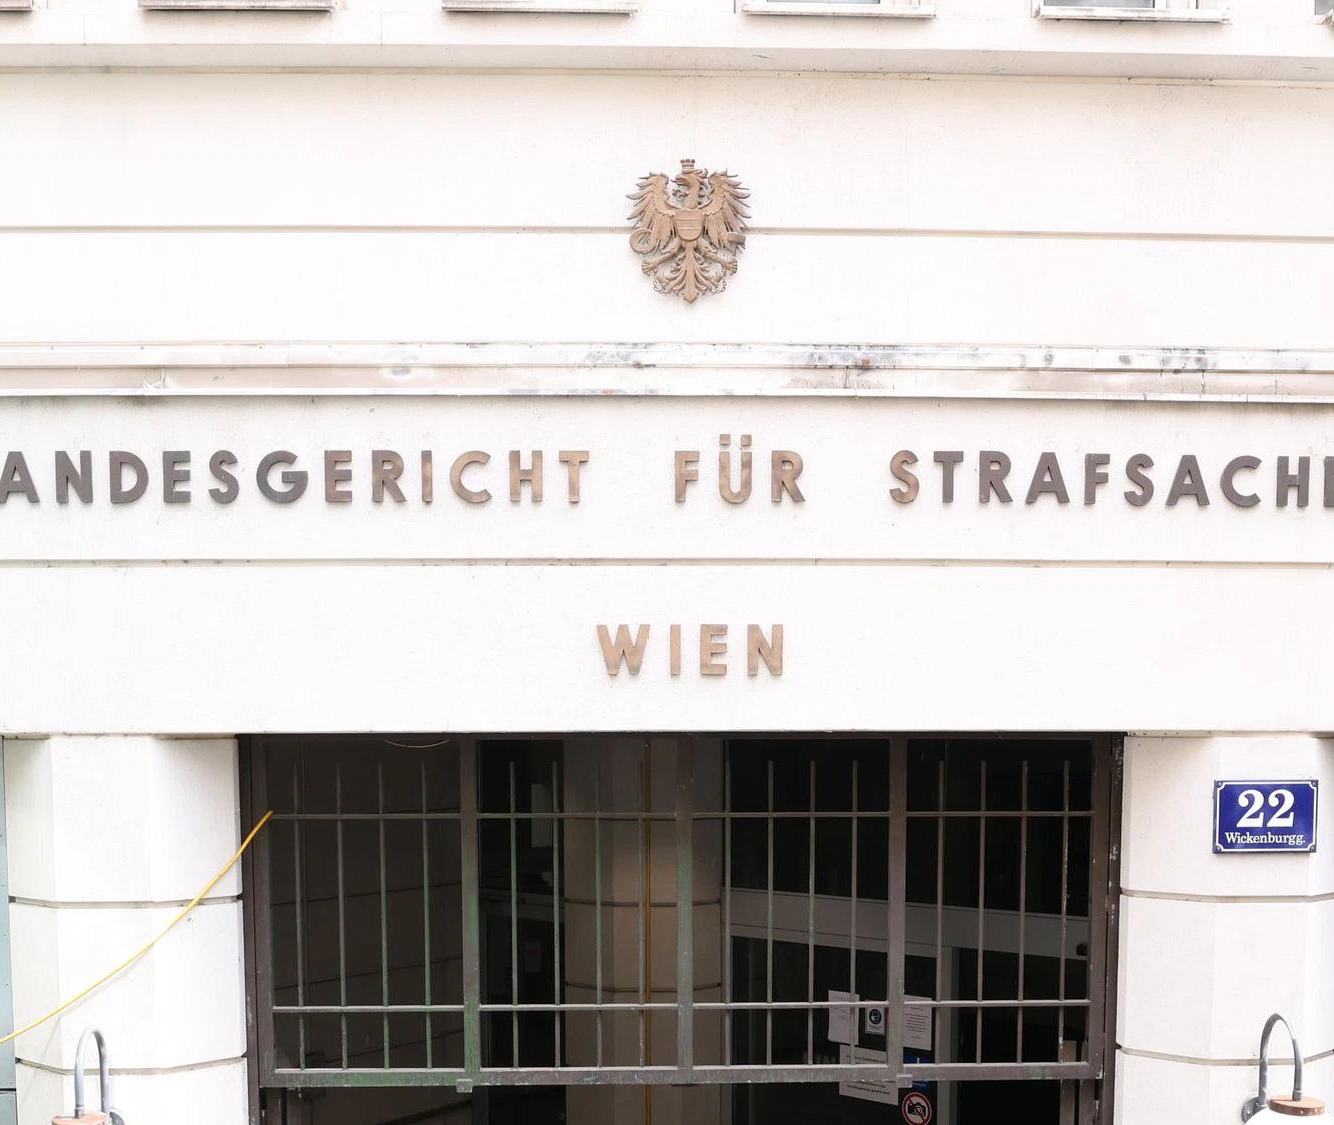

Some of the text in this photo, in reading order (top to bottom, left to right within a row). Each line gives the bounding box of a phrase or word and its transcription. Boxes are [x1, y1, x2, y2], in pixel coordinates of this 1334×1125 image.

[673, 433, 807, 506] FÜR
[596, 623, 785, 679] WIEN
[1236, 788, 1295, 828] 22
[1225, 831, 1306, 846] Wickenburgg.
